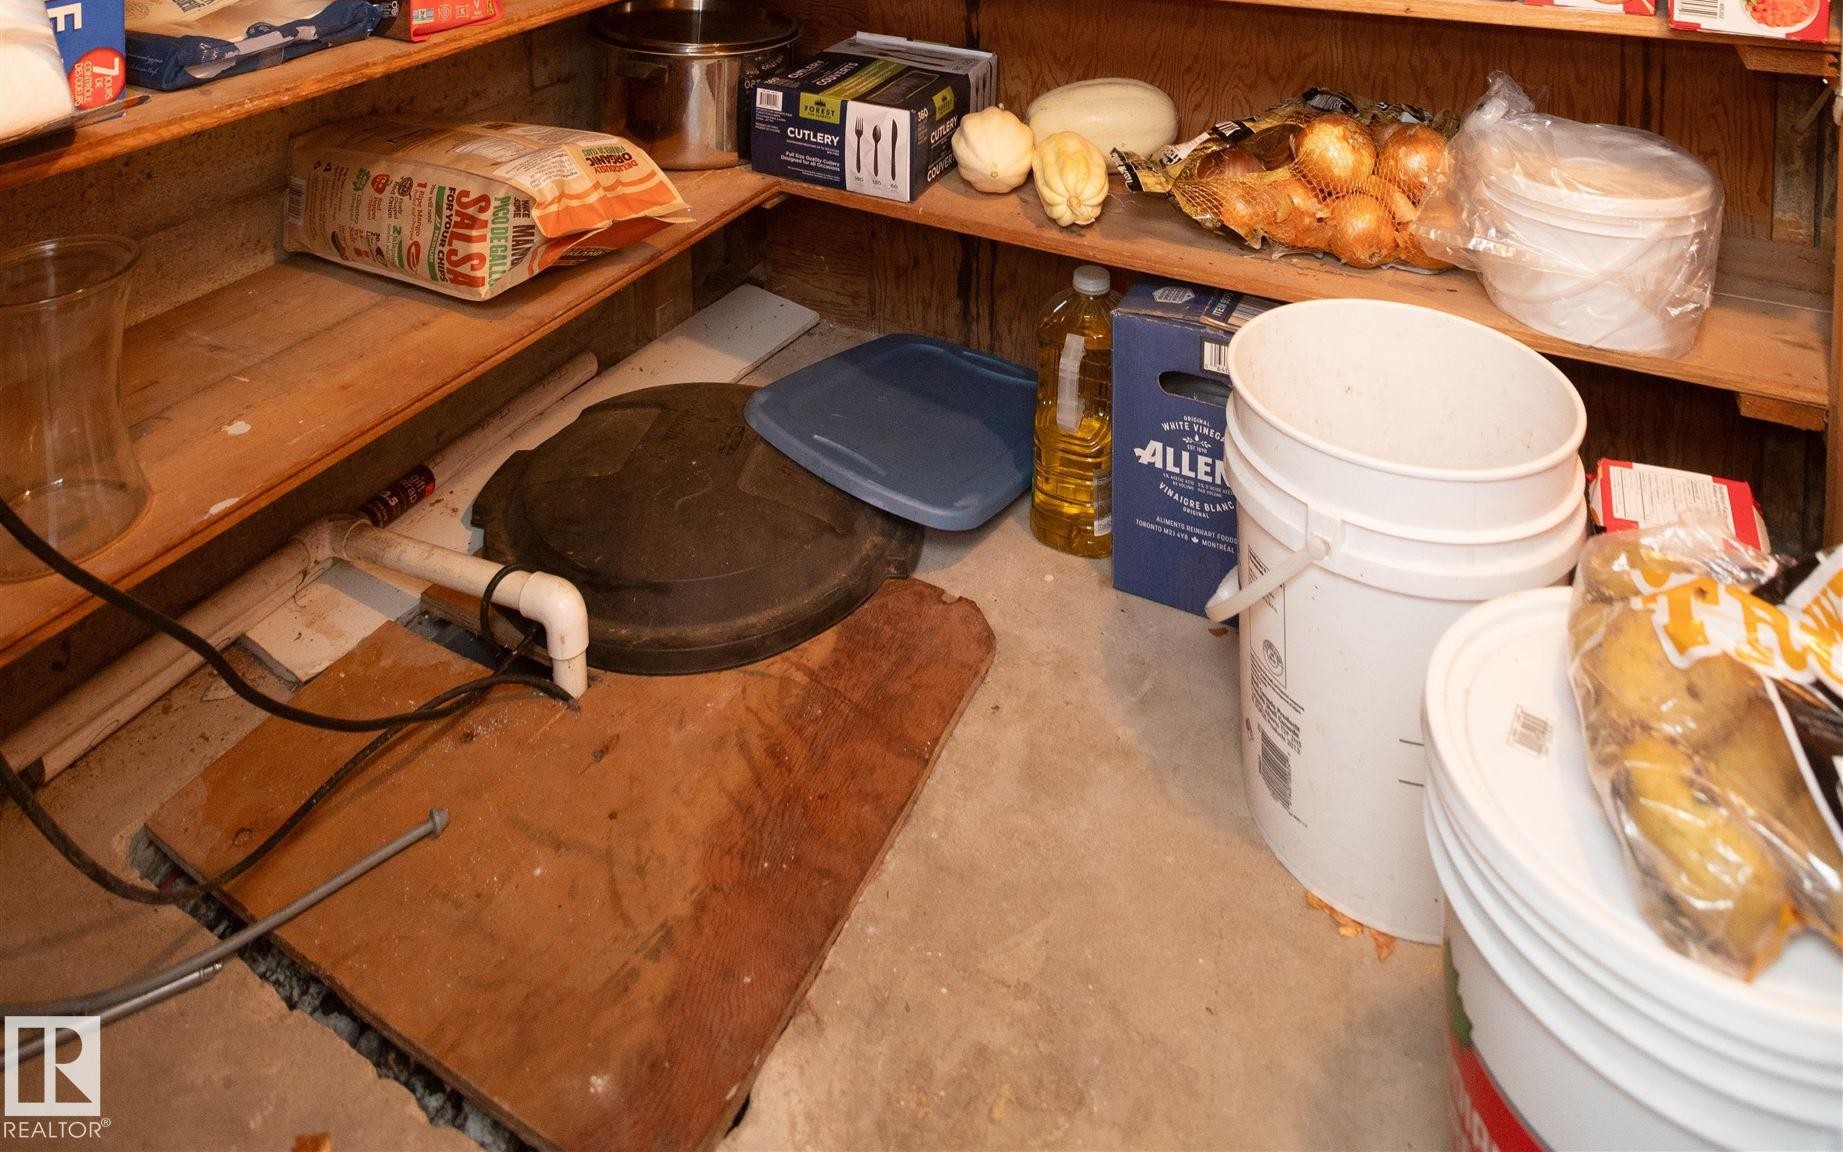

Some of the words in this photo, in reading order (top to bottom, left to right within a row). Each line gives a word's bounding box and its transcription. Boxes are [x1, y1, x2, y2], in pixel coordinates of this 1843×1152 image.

[75, 63, 83, 76] DES
[92, 57, 119, 76] 7
[788, 60, 825, 79] CUTLERY
[816, 62, 858, 86] COUVERTS
[75, 76, 83, 107] ODEURS
[83, 62, 94, 103] CONTRÔLE
[95, 77, 103, 88] DE
[104, 75, 113, 100] JOURS
[805, 105, 834, 117] FOREST
[917, 108, 928, 121] 360
[787, 127, 839, 146] CUTLERY
[930, 115, 958, 143] CUTLERY
[585, 152, 632, 166] ORGANIC
[594, 159, 638, 174] DELICIOUSLY
[781, 155, 801, 165] Designed
[817, 162, 840, 172] Occasions
[806, 154, 821, 163] Quality
[823, 158, 840, 167] Cutlery
[927, 154, 954, 182] COUVER
[390, 182, 399, 194] Red
[417, 191, 425, 207] Ripe
[446, 187, 456, 211] FOR
[513, 197, 521, 218] SOME
[522, 199, 531, 218] MAKE
[492, 196, 511, 225] PICO
[415, 210, 424, 237] Mango
[438, 212, 454, 248] YOUR
[446, 190, 491, 288] SALSA
[490, 226, 508, 243] DE
[429, 230, 440, 263] MEDIUM
[437, 249, 448, 282] CHIPS
[1183, 415, 1210, 426] ORIGINAL
[1161, 421, 1190, 431] WHITE
[1193, 424, 1225, 442] VINEGA
[1134, 440, 1228, 486] ALLEN
[401, 479, 417, 503] wrap
[1160, 481, 1200, 510] VINAIGRE
[1204, 501, 1235, 512] BLANC
[1183, 507, 1210, 519] ORIGINAL
[1135, 519, 1162, 532] TORONTO
[1201, 539, 1235, 554] MONTRÉAL
[1156, 516, 1185, 530] ALIMENTS
[1186, 524, 1215, 538] REINHART
[1217, 533, 1237, 544] FOODS
